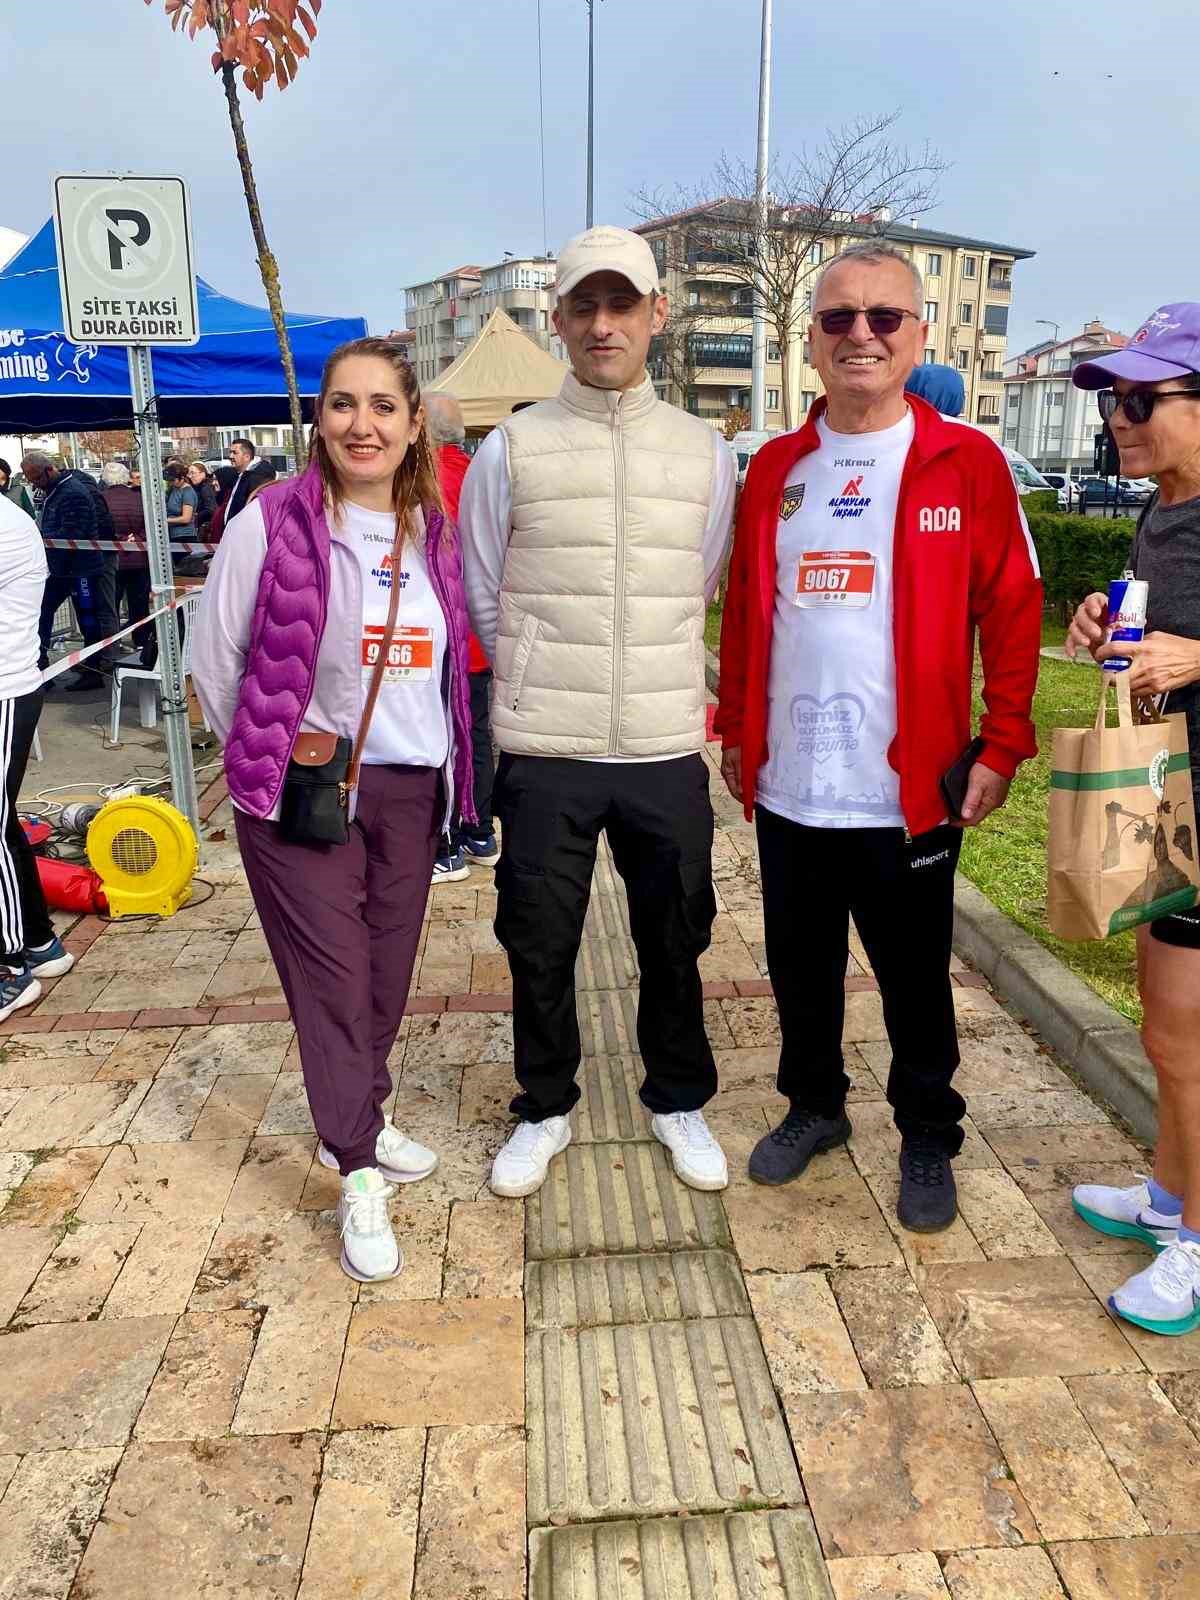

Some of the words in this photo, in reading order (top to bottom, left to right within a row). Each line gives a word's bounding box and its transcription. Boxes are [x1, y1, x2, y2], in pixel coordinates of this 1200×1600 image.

[82, 296, 122, 315] SİTE
[126, 296, 178, 315] TAKSİ
[81, 316, 183, 335] DURAĞIDIR!
[828, 497, 872, 507] ALPAYLAR
[832, 506, 864, 519] İNŞAAT
[920, 506, 961, 532] ADA
[371, 568, 410, 581] ALPAAR
[804, 568, 851, 591] 9067
[366, 643, 413, 665] 966
[911, 850, 949, 868] uhlsport
